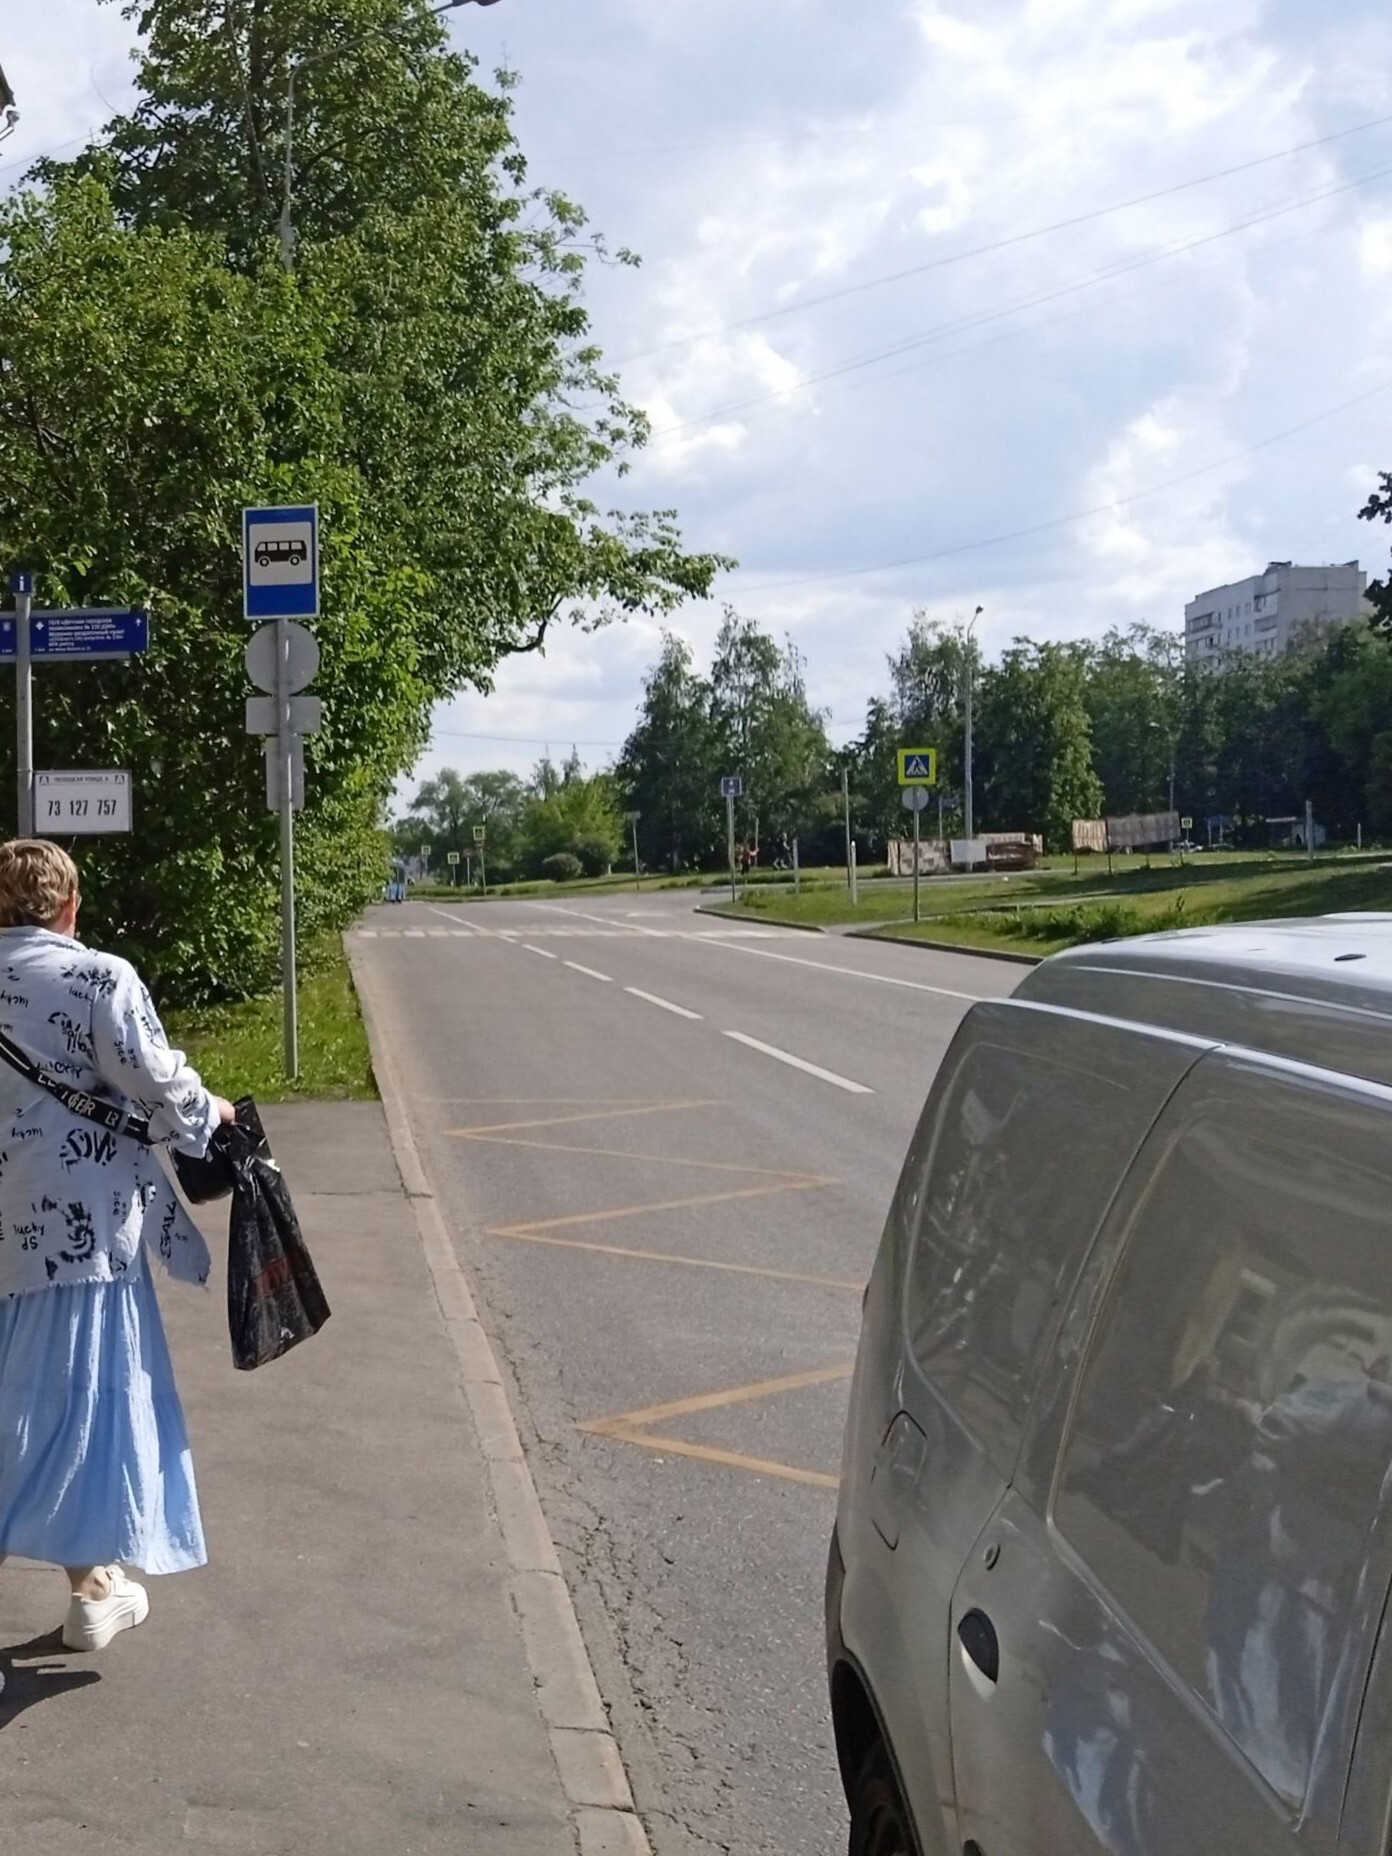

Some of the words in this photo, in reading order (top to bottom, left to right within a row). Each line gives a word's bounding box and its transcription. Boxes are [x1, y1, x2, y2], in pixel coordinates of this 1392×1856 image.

[48, 800, 61, 816] 73
[69, 800, 88, 816] 127
[97, 799, 117, 816] 757
